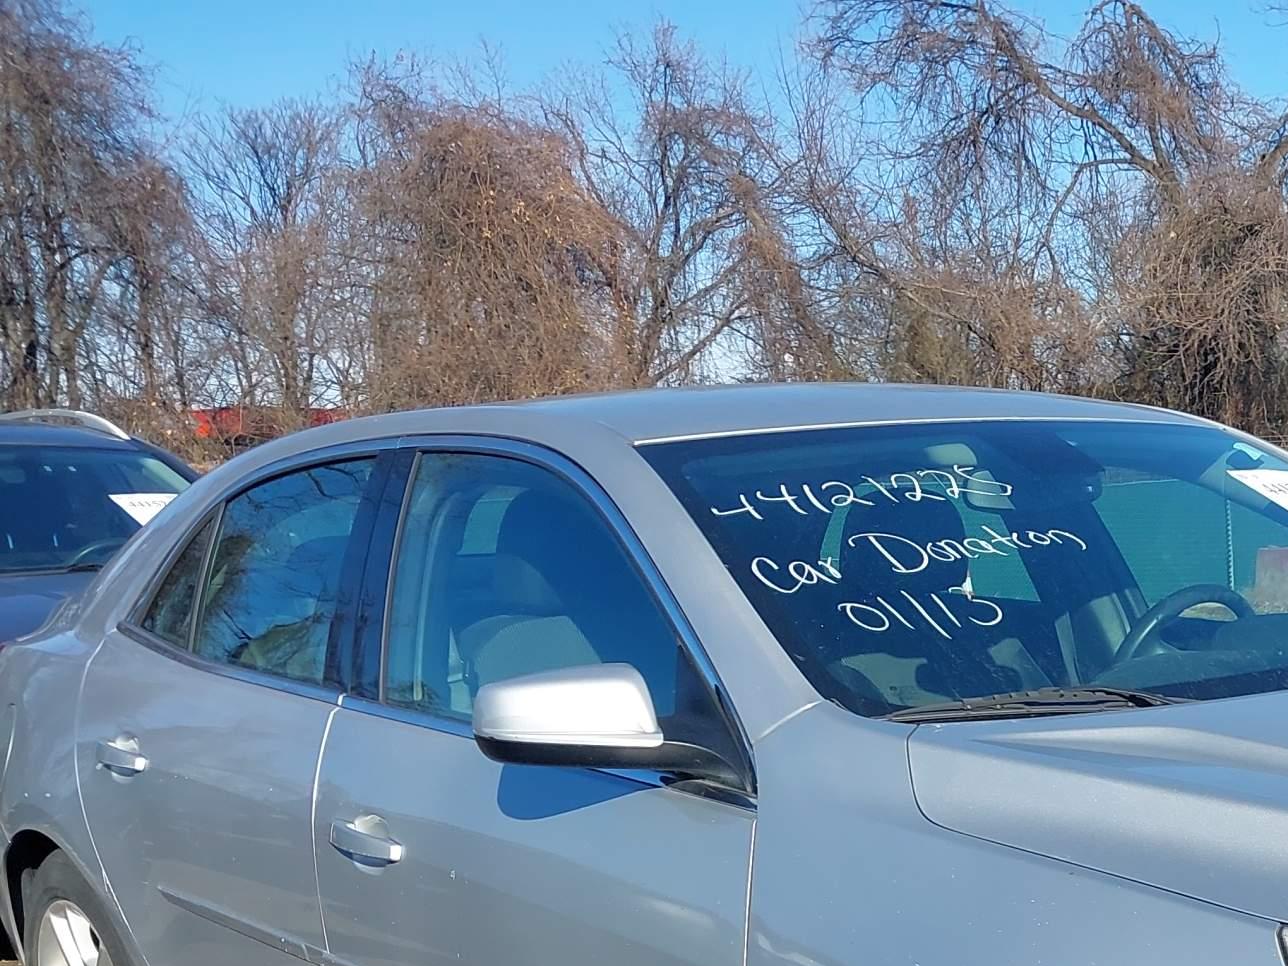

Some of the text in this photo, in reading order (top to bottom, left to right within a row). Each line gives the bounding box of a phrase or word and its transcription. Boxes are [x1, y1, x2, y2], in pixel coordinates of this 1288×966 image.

[710, 463, 1013, 522] 44121225
[751, 555, 841, 596] Car
[837, 583, 1004, 640] 01/13
